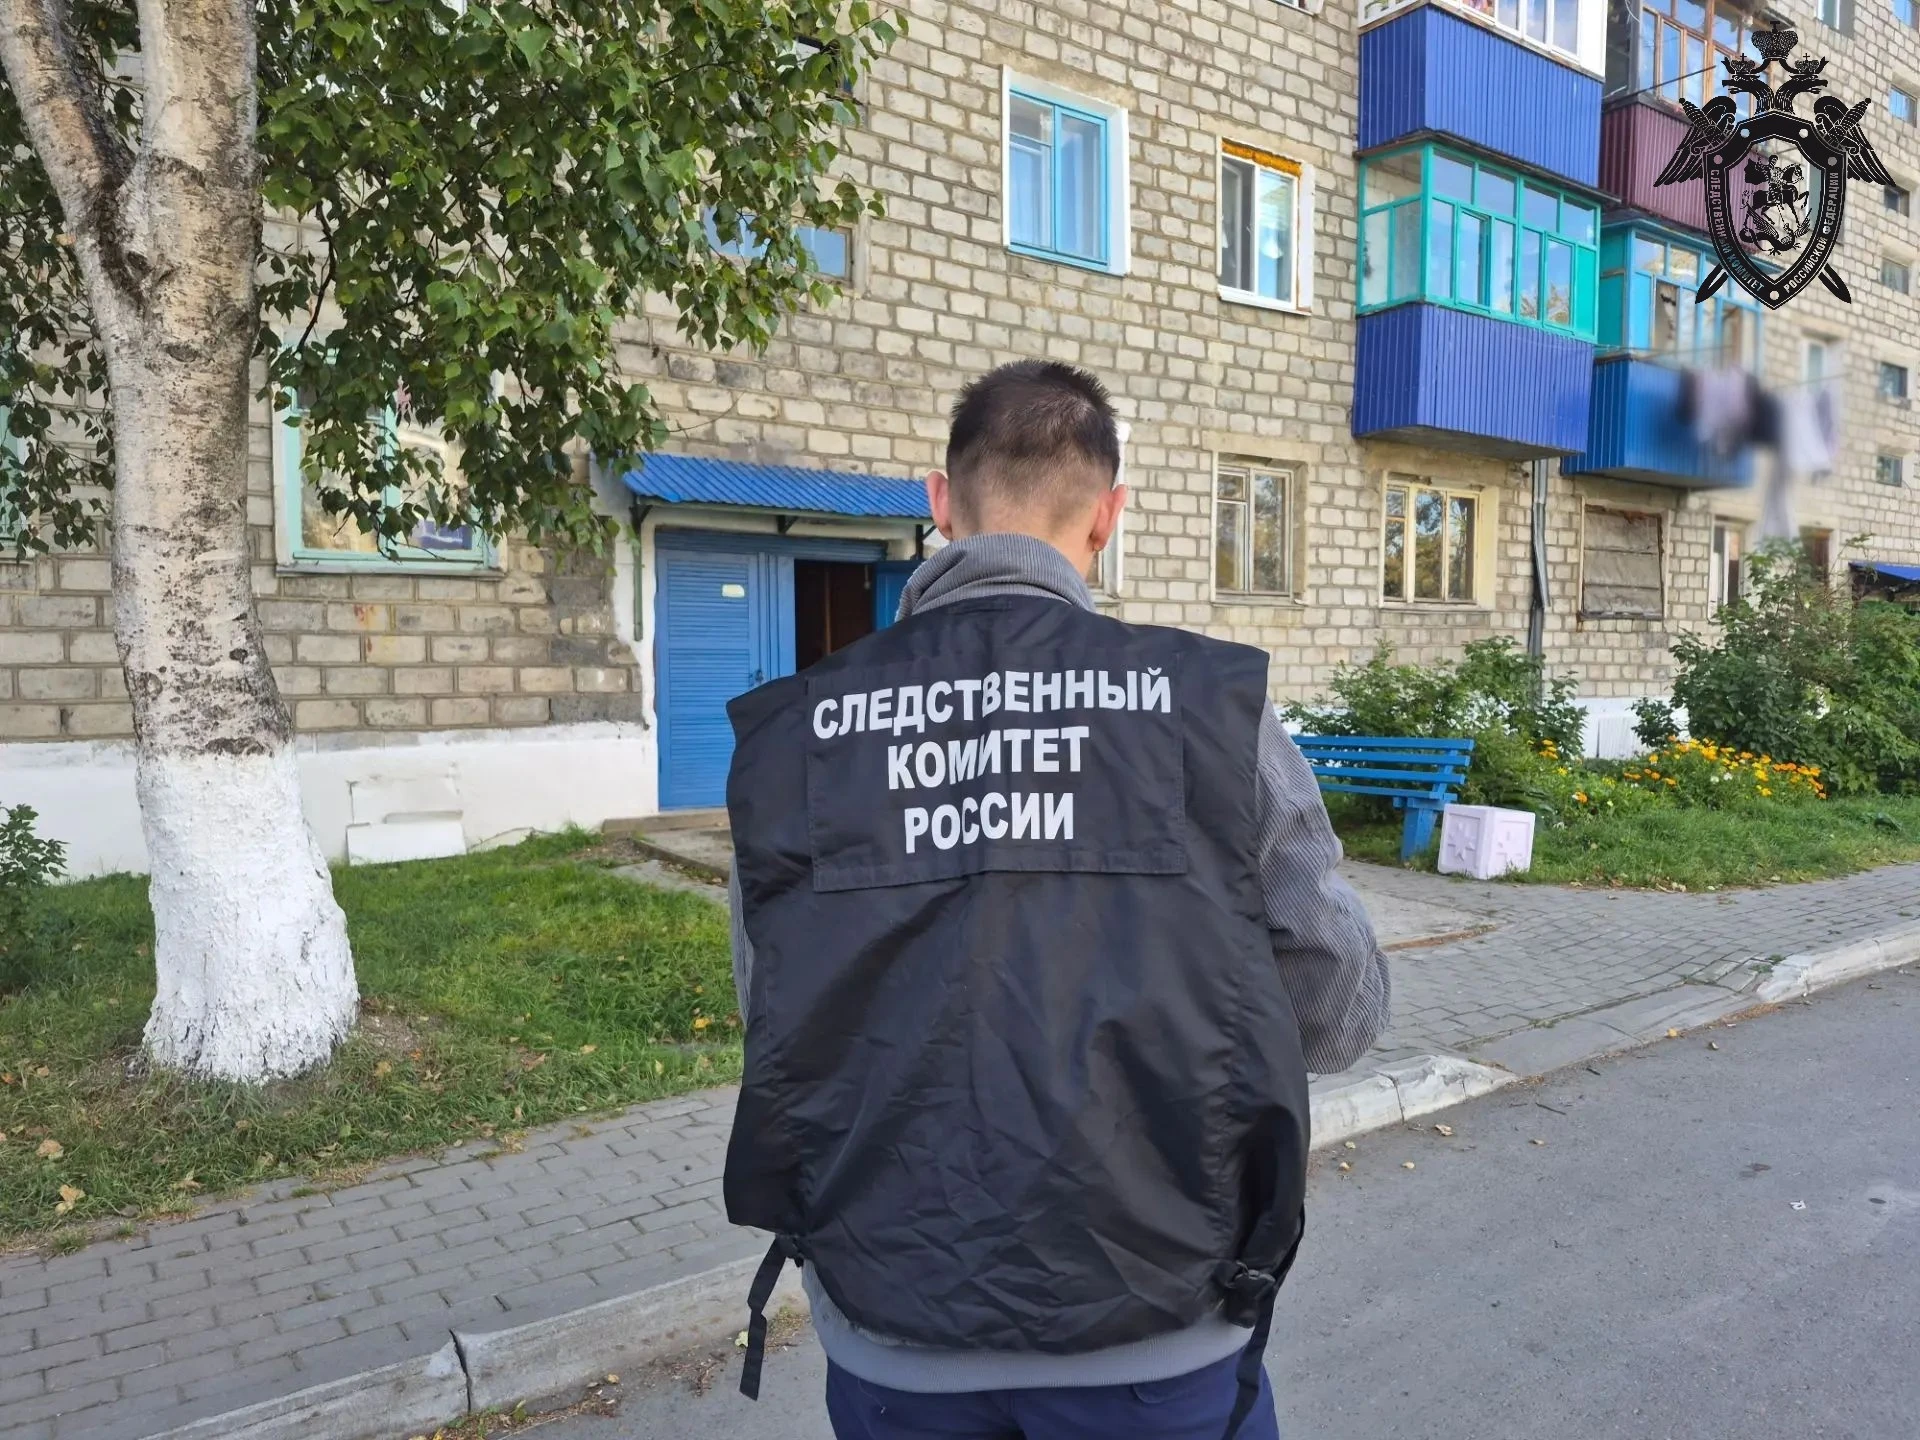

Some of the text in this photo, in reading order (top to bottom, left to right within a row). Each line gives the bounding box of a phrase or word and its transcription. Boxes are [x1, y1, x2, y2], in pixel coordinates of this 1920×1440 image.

[813, 667, 1171, 739] СЛЕДСТВЕННЫЙ
[888, 726, 1089, 790] КОМИТЕТ
[905, 792, 1074, 854] РОССИИ
